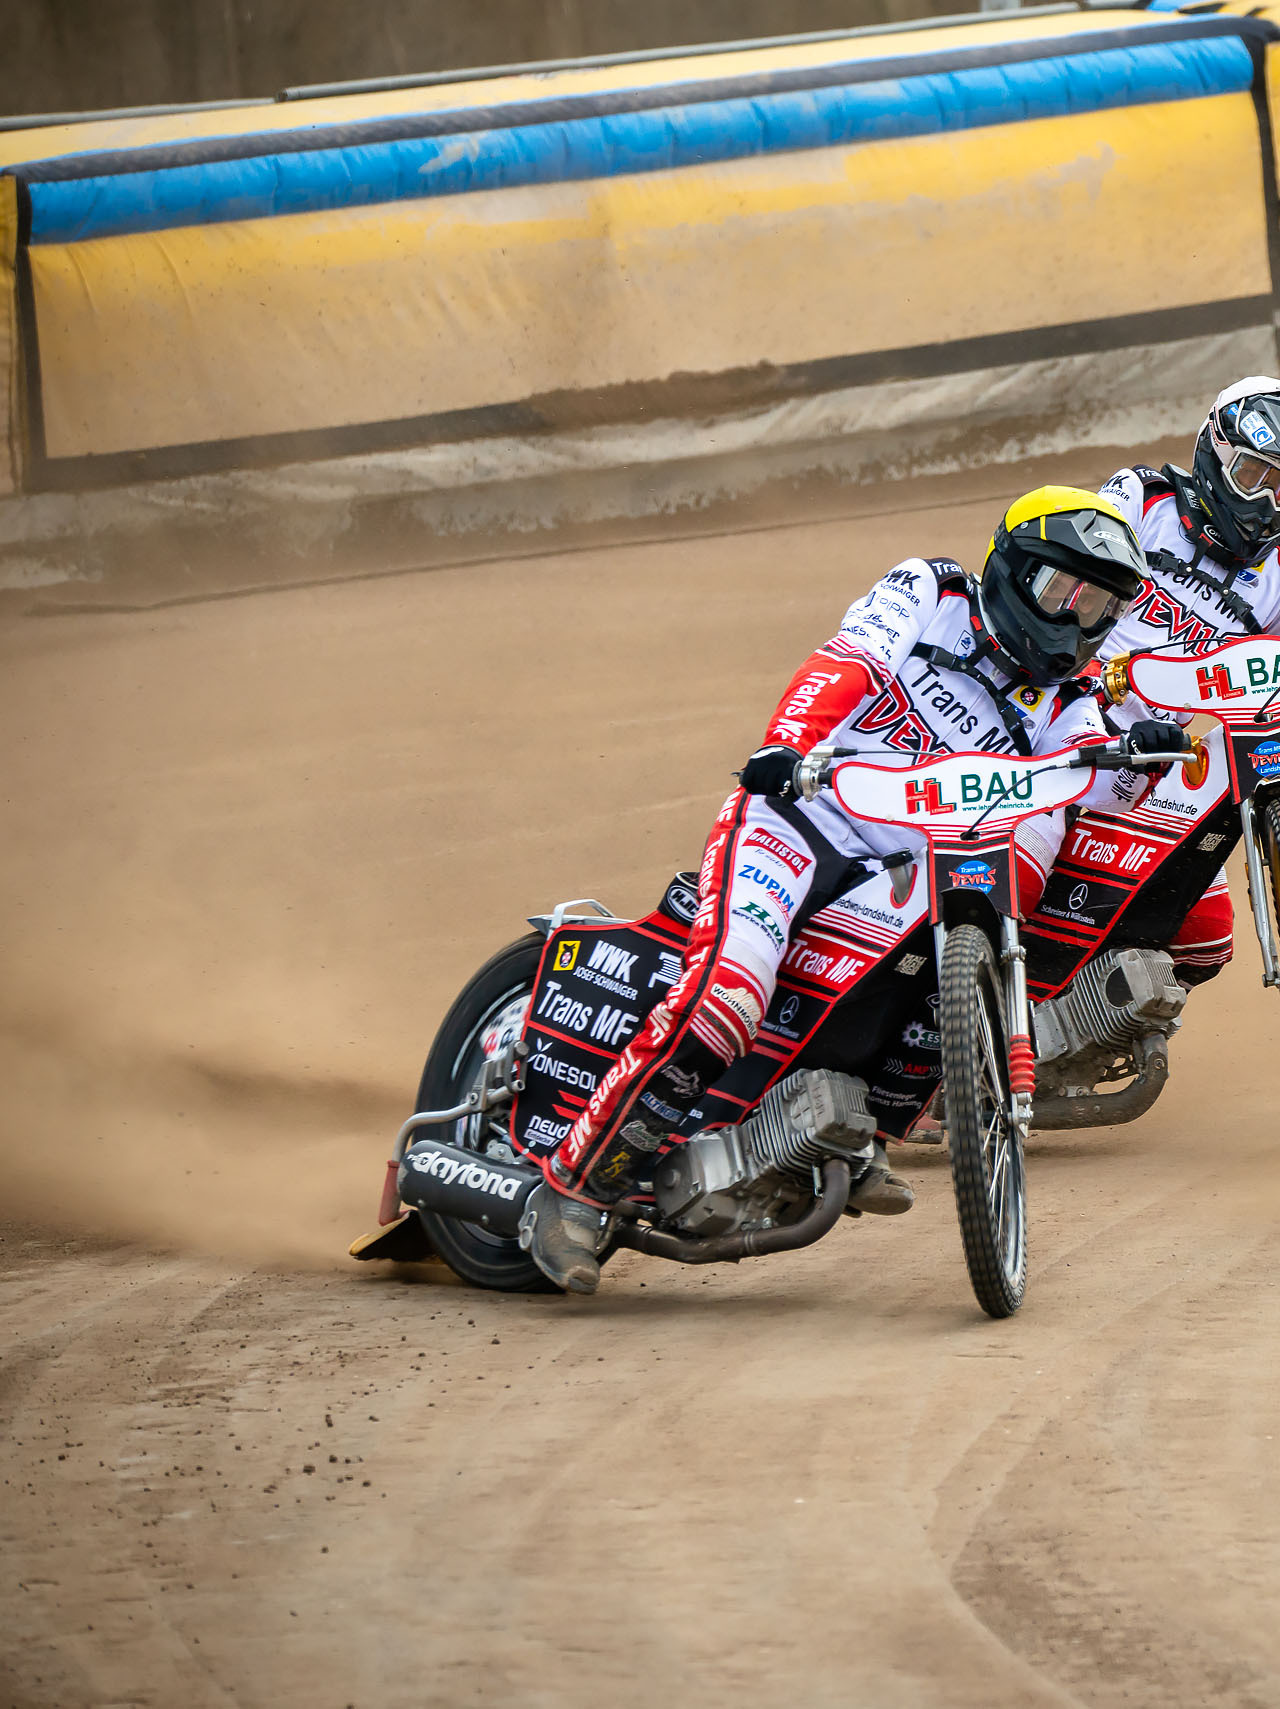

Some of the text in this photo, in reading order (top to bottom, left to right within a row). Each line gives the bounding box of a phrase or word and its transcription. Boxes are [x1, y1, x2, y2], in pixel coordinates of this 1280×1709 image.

[1133, 578, 1247, 656] DEVIL
[785, 672, 842, 717] Trans
[911, 662, 979, 735] Trans
[1195, 663, 1247, 701] HL
[850, 664, 956, 766] DEV
[904, 769, 1033, 815] HL BAU
[747, 831, 806, 873] BALLISTOL
[1070, 827, 1120, 865] Trans
[1118, 842, 1158, 873] MF
[737, 864, 795, 912] ZUPIN
[948, 868, 997, 888] DEVILS
[671, 889, 700, 917] HJC
[573, 965, 638, 1001] JOSEF SCHWAIGER
[587, 940, 640, 984] WWK
[786, 938, 835, 976] Trans
[825, 955, 867, 985] MF
[537, 981, 640, 1046] Trans MF
[588, 1046, 642, 1116] Trans
[528, 1114, 572, 1140] neud
[567, 1111, 592, 1162] MF
[412, 1151, 523, 1201] daytona
